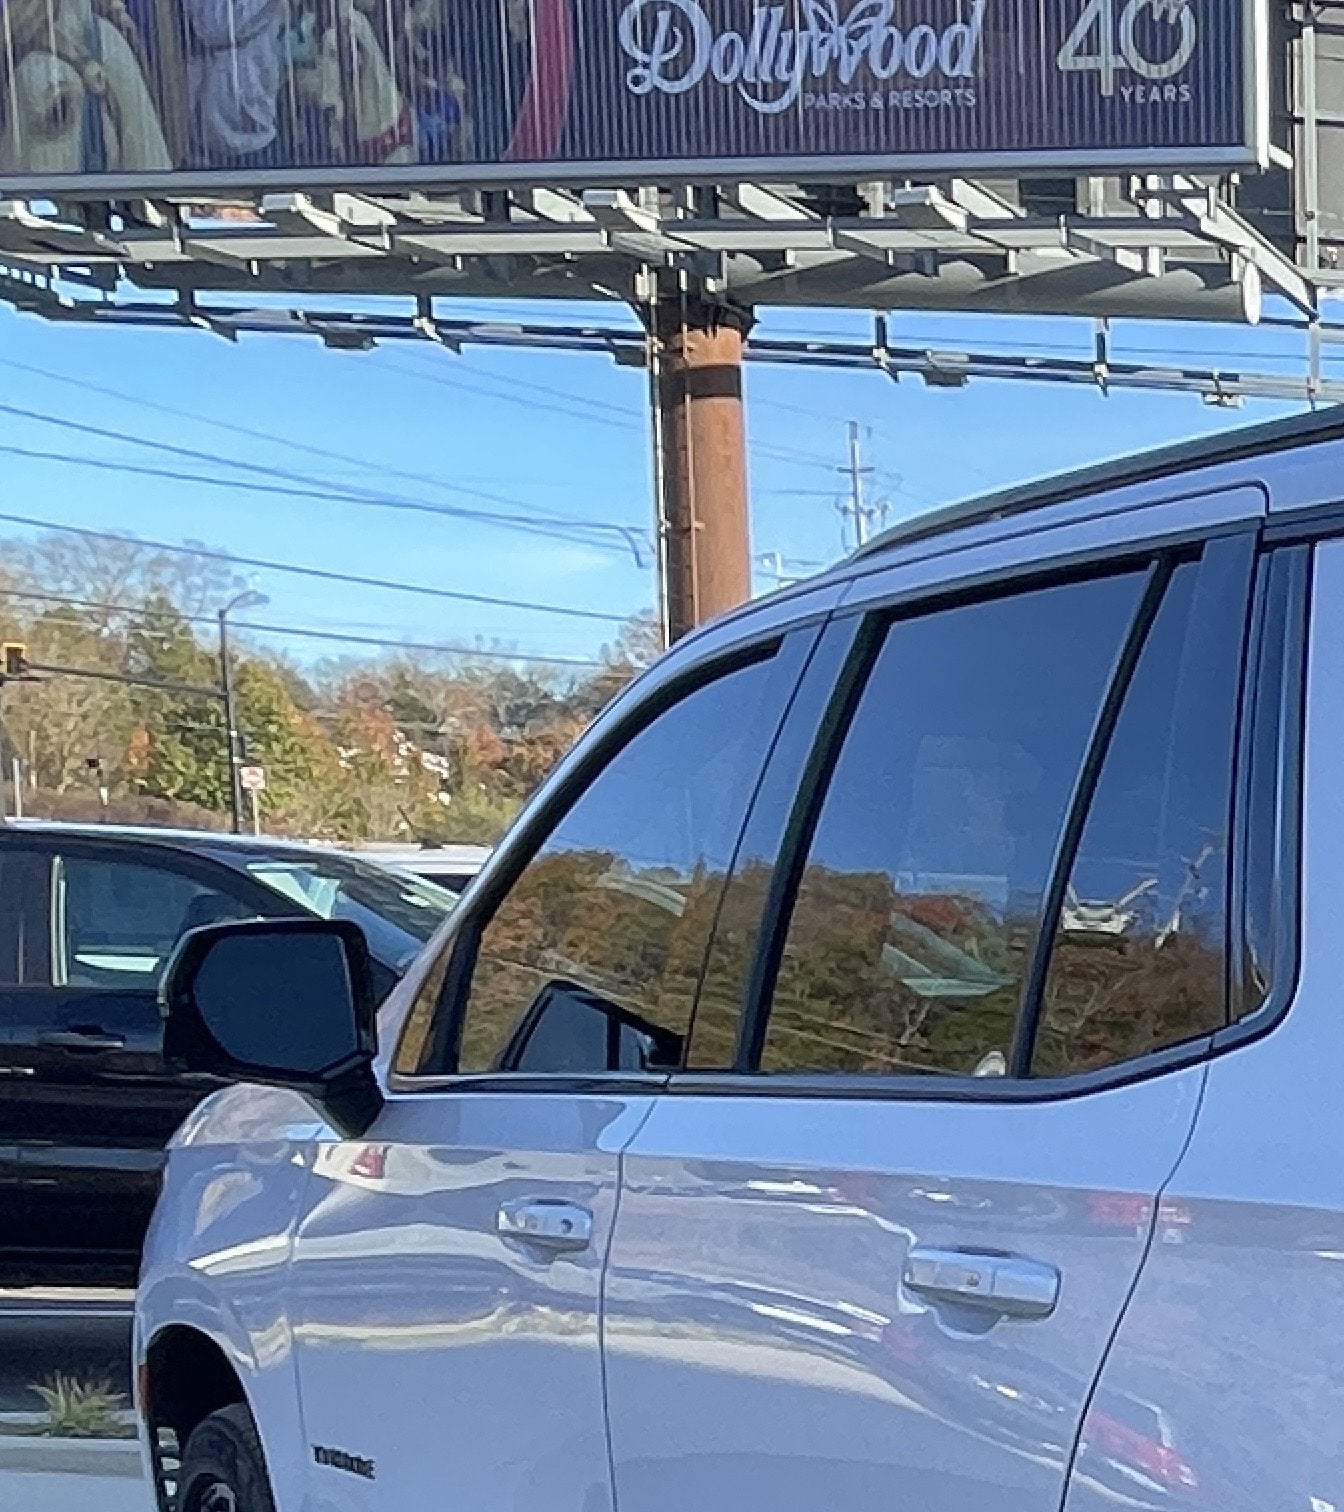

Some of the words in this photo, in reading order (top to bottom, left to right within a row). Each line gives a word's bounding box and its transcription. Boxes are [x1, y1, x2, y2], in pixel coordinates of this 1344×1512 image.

[803, 91, 866, 111] PARKS
[889, 88, 976, 109] RESORTS
[1120, 83, 1192, 104] YEARS
